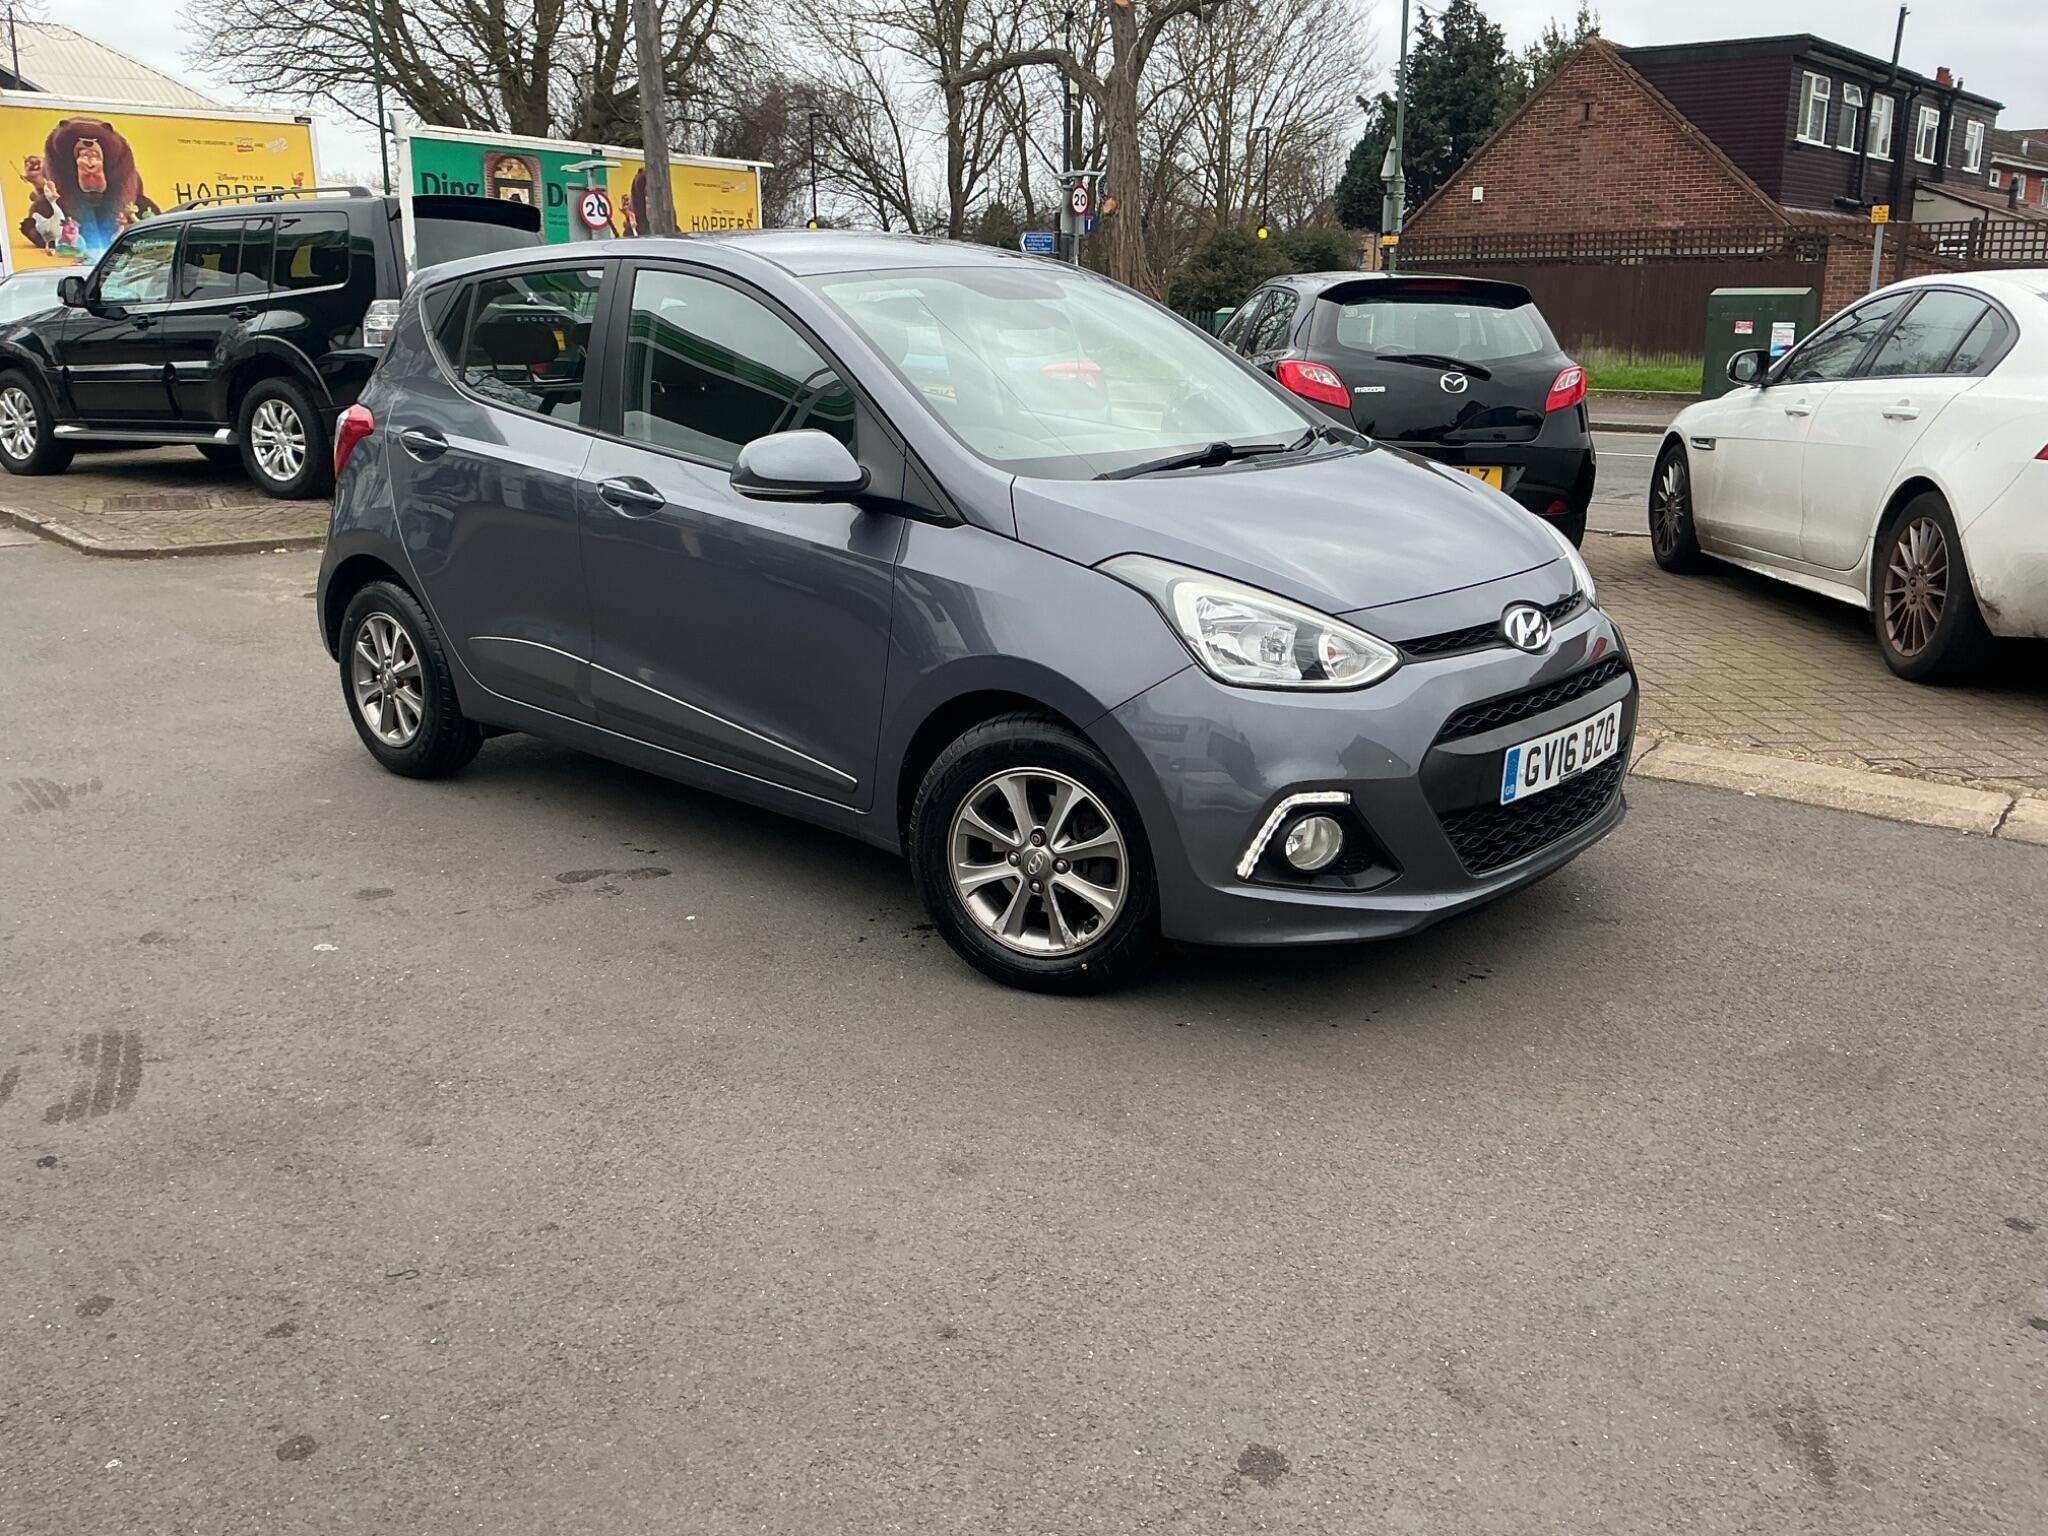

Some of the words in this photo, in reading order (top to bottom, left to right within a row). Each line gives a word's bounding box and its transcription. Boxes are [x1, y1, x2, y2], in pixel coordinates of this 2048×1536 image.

[420, 172, 480, 195] Ding
[546, 182, 568, 207] D
[1074, 194, 1087, 206] 20
[585, 201, 608, 217] 20
[1525, 733, 1579, 787] GV16
[1582, 712, 1616, 765] BZO
